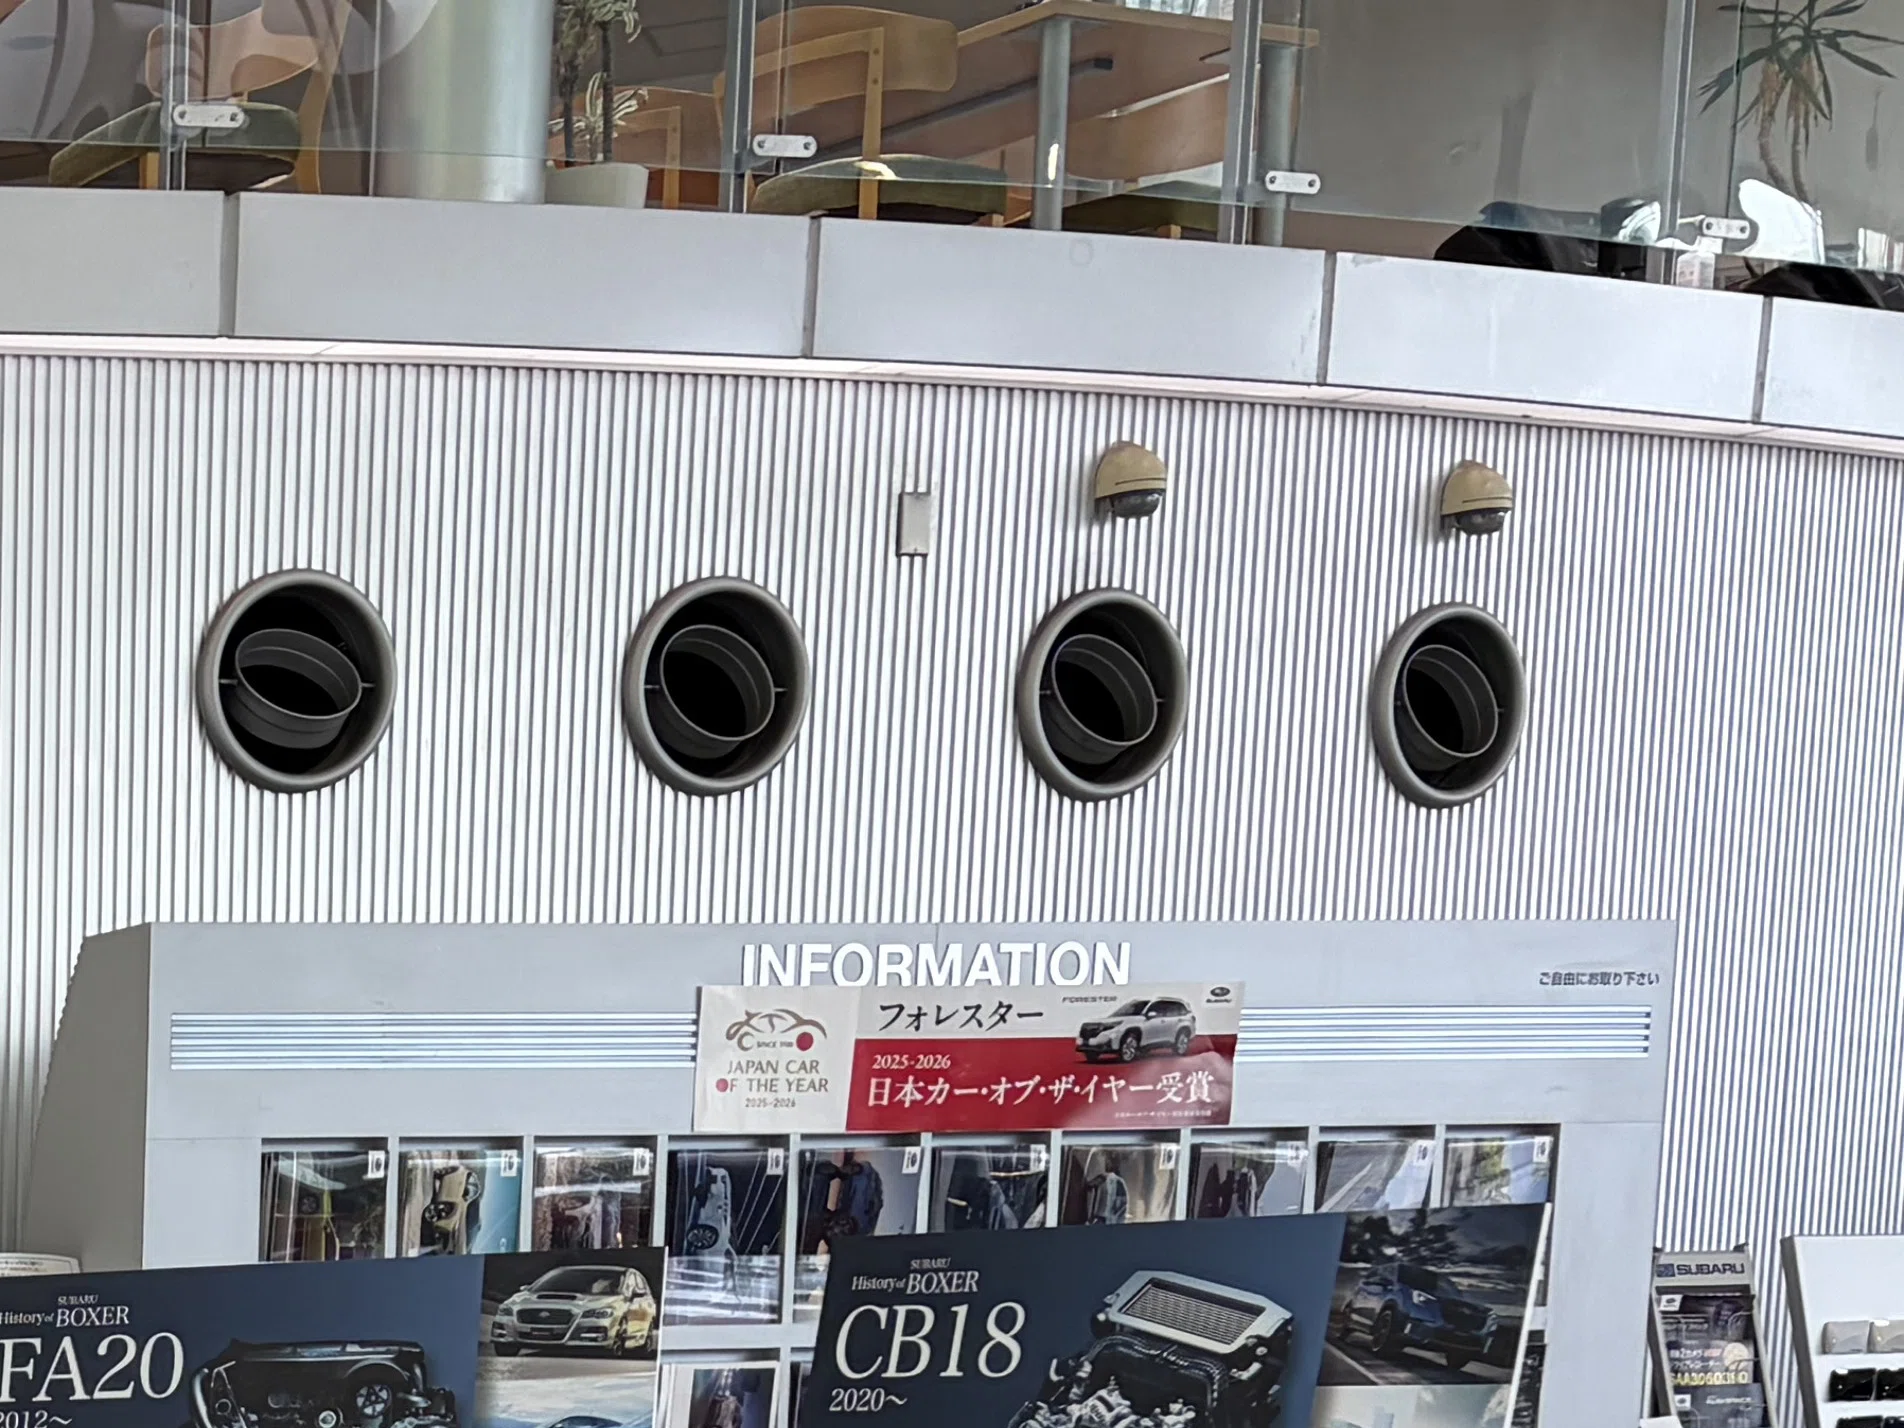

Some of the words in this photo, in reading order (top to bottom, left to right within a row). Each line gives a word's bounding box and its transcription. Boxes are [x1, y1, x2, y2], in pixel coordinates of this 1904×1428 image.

[743, 942, 1131, 986] INFORMATION
[879, 1000, 1044, 1032] フォレスター
[727, 1060, 779, 1074] JAPAN
[785, 1060, 820, 1074] CAR
[871, 1054, 951, 1070] 2025-2026
[746, 1078, 779, 1092] THE
[785, 1078, 829, 1092] YEAR
[1676, 1263, 1746, 1276] SUBARU
[851, 1275, 896, 1292] History
[896, 1278, 906, 1288] of
[905, 1270, 980, 1295] BOXER
[44, 1313, 54, 1322] of
[55, 1305, 130, 1328] BOXER
[835, 1302, 1026, 1380] CB18
